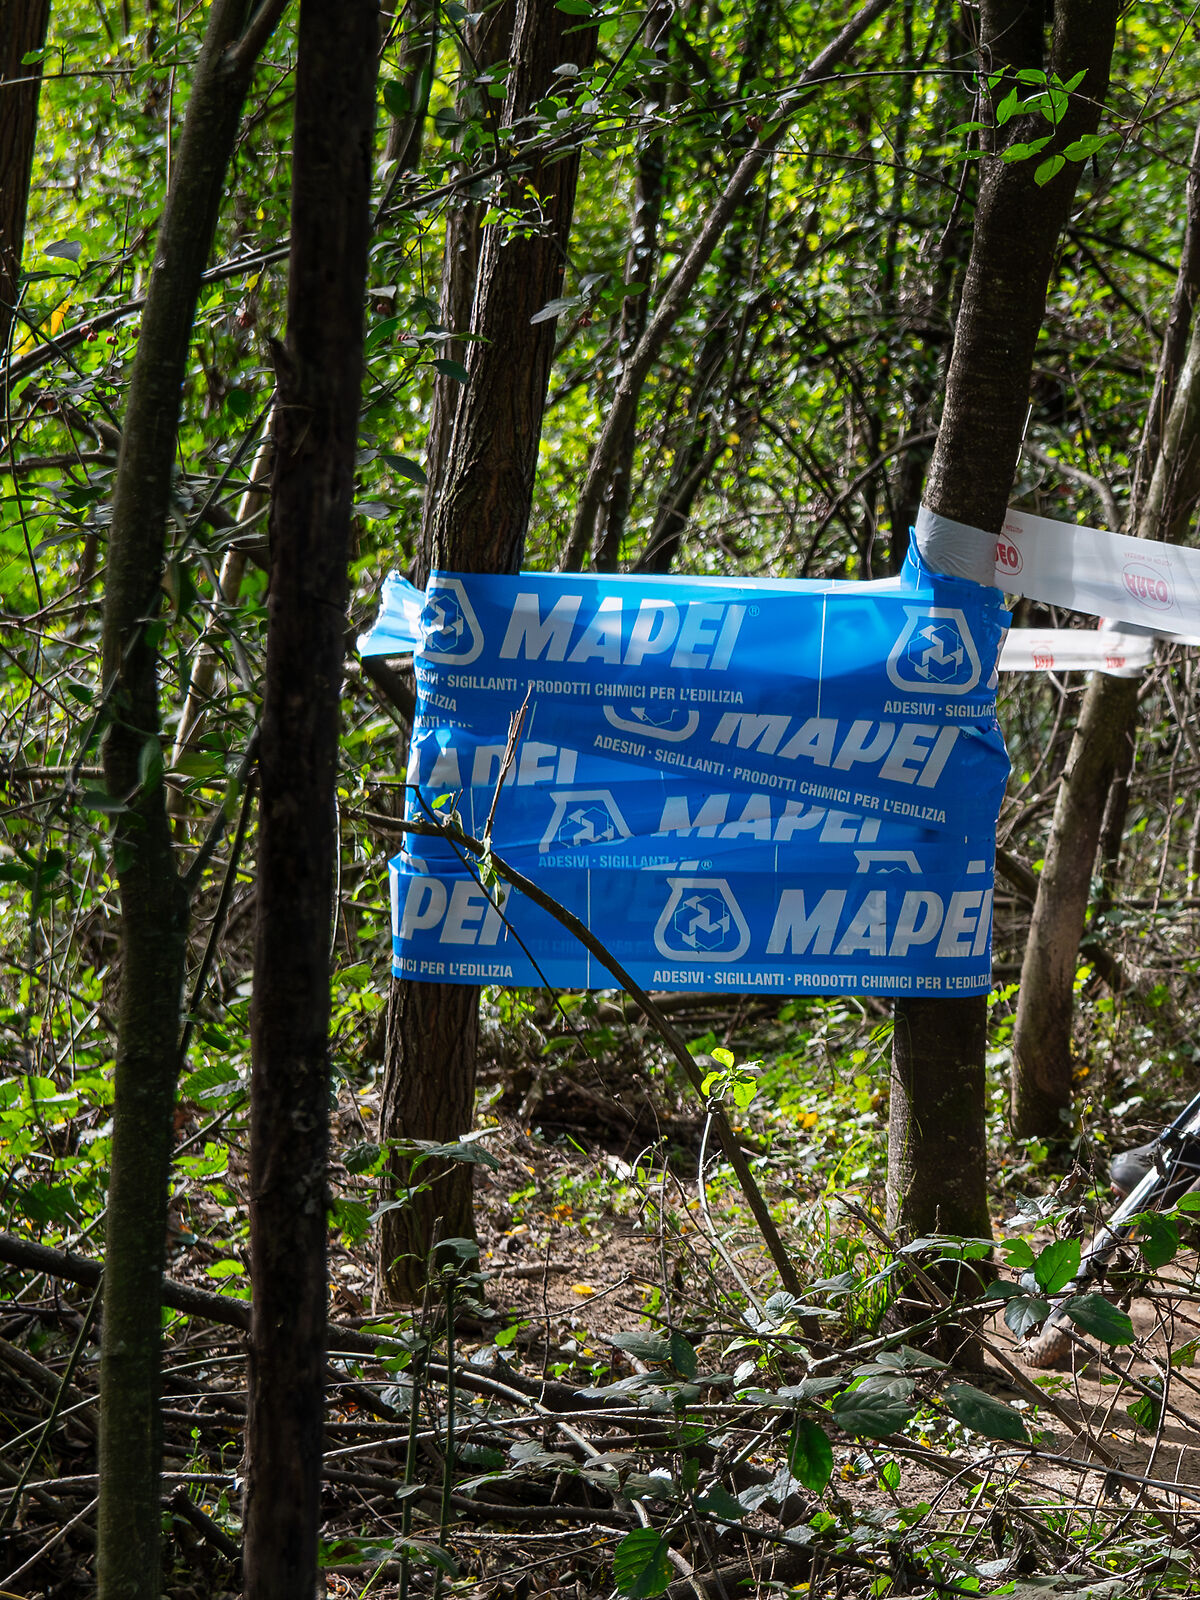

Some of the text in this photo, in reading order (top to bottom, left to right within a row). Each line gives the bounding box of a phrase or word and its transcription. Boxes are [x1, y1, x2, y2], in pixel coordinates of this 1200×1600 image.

[499, 592, 748, 671] MAPEI
[447, 674, 518, 692] SIGILLANTI
[527, 679, 591, 696] PRODOTTI
[595, 682, 646, 699] CHIMICI
[650, 686, 675, 701] PER
[680, 688, 744, 705] L'EDILIZIA
[883, 700, 995, 718] ADESIVI SIGILLANT
[710, 712, 961, 789] MAPEI
[593, 734, 947, 824] ADESIVI SIGILLANTI PRODOTTI CHIMICI PER L'EDILIZIA
[538, 855, 590, 869] ADESIVI
[390, 872, 512, 946] PEI
[765, 887, 994, 958] MAPEI
[420, 961, 445, 975] PER
[449, 963, 513, 978] L'EDILIZIA
[653, 970, 705, 984] ADESIVI
[714, 972, 785, 986] SIGILLANTI
[794, 974, 857, 988] PRODOTTI
[861, 975, 912, 989] CHIMICI
[916, 976, 942, 990] PER
